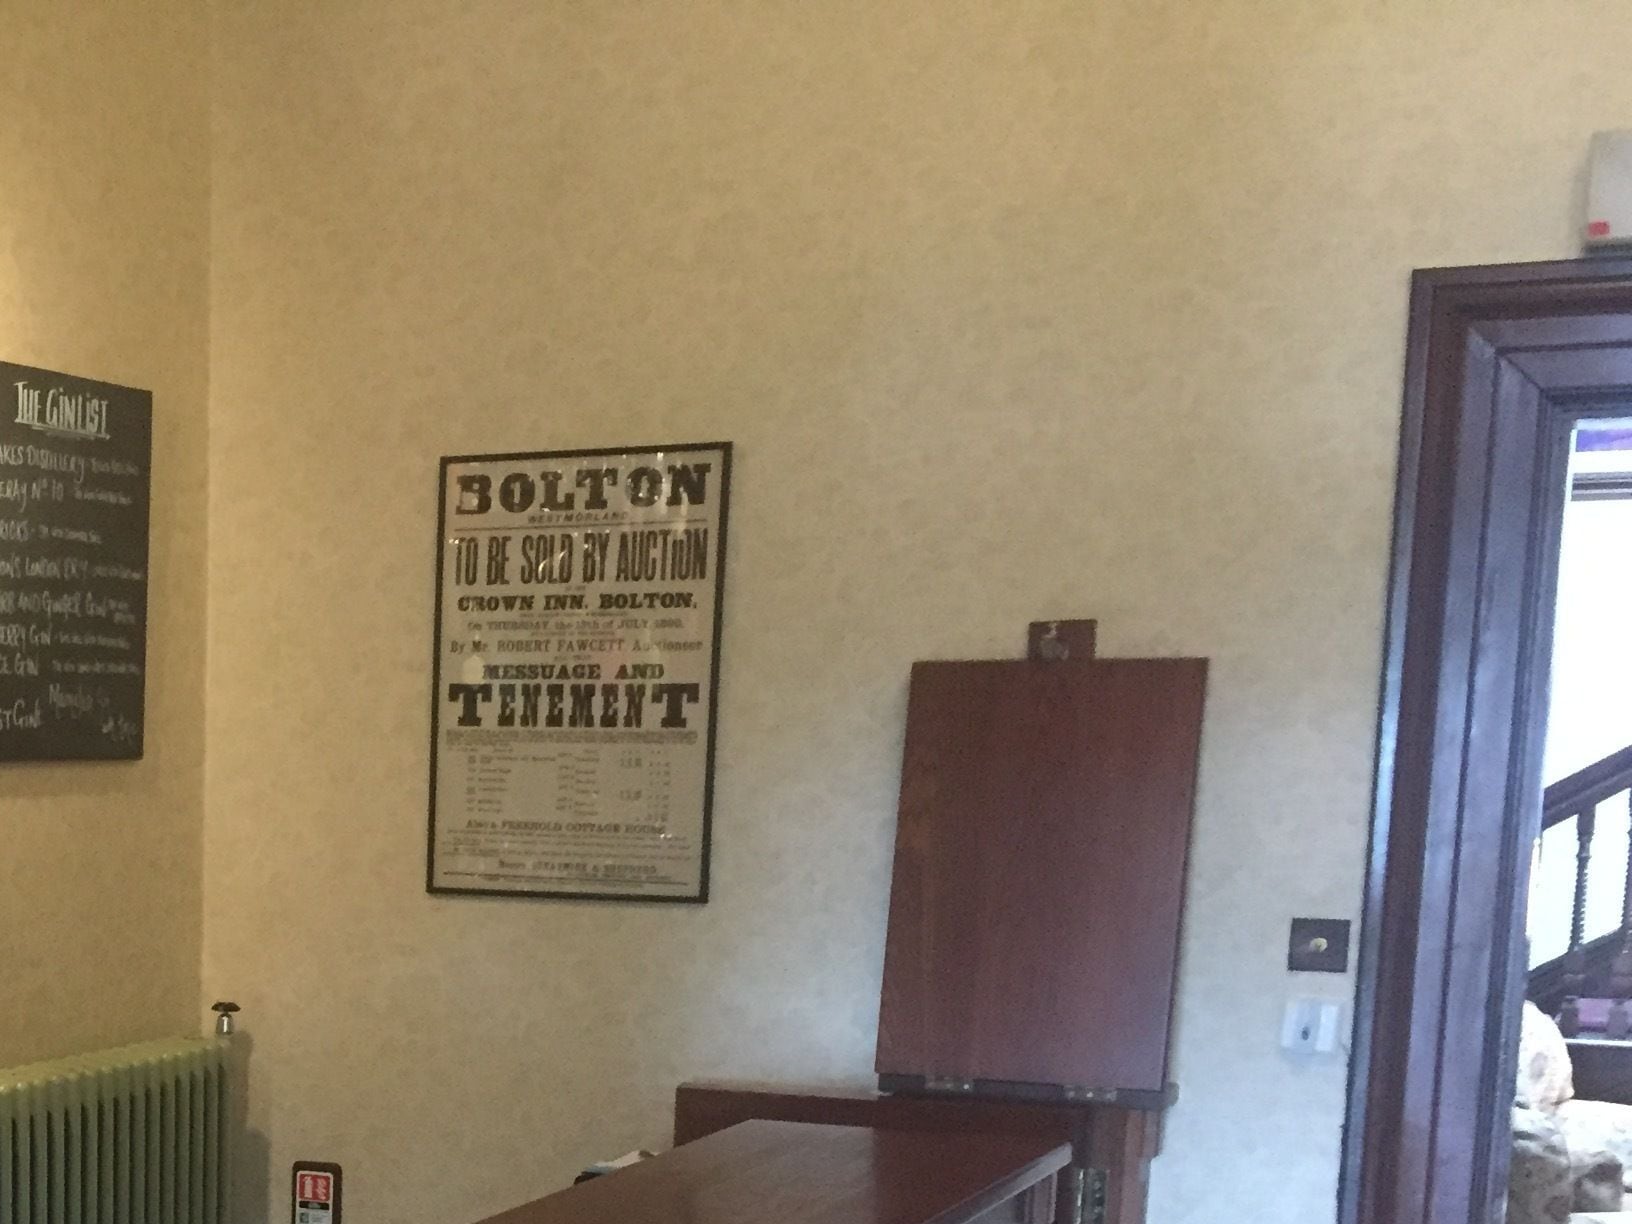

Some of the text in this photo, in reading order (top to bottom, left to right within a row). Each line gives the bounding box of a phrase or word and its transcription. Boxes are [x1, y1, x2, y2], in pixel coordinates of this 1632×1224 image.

[455, 463, 712, 516] BOLTON
[455, 528, 709, 586] TO BE SOLD BY AUCTION
[457, 595, 536, 611] CROWN
[496, 639, 552, 652] ROBERT
[557, 639, 625, 653] FAWCETT
[632, 639, 703, 651] Autioneer
[481, 663, 665, 680] MESSUAGE AND
[448, 683, 700, 728] TENEMENT
